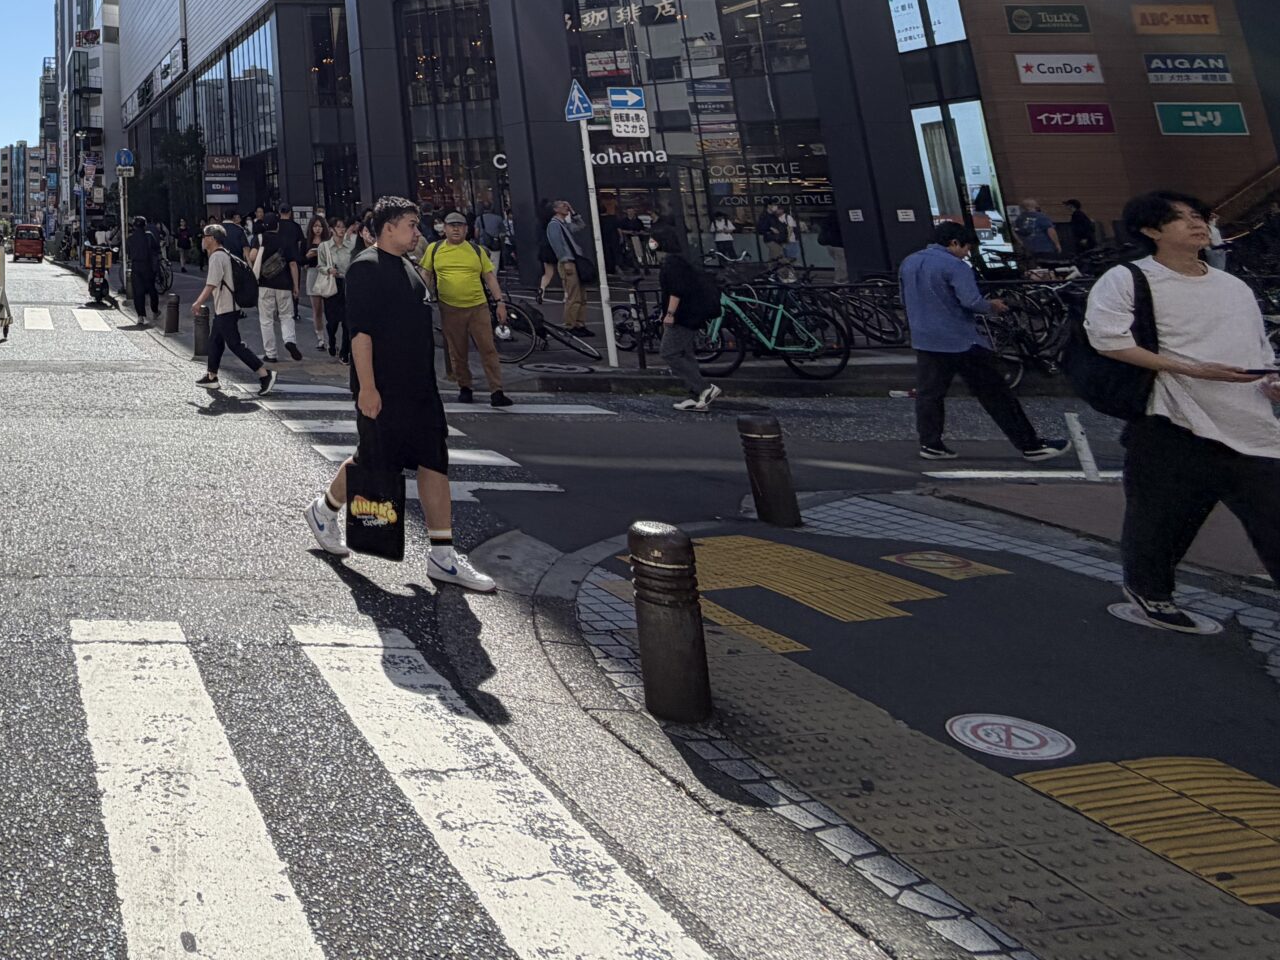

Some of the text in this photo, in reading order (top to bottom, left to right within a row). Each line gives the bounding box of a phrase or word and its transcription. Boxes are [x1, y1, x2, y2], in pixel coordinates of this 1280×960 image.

[1140, 13, 1210, 26] ABC-MART
[1036, 63, 1082, 74] CanDo
[1150, 59, 1224, 69] AIGAN
[613, 113, 646, 123] 自転車を除く
[1036, 112, 1104, 126] イオン銀行
[1181, 111, 1222, 127] ニトリ
[615, 124, 646, 135] ここから
[752, 162, 801, 176] STYLE
[794, 195, 833, 205] STYLE
